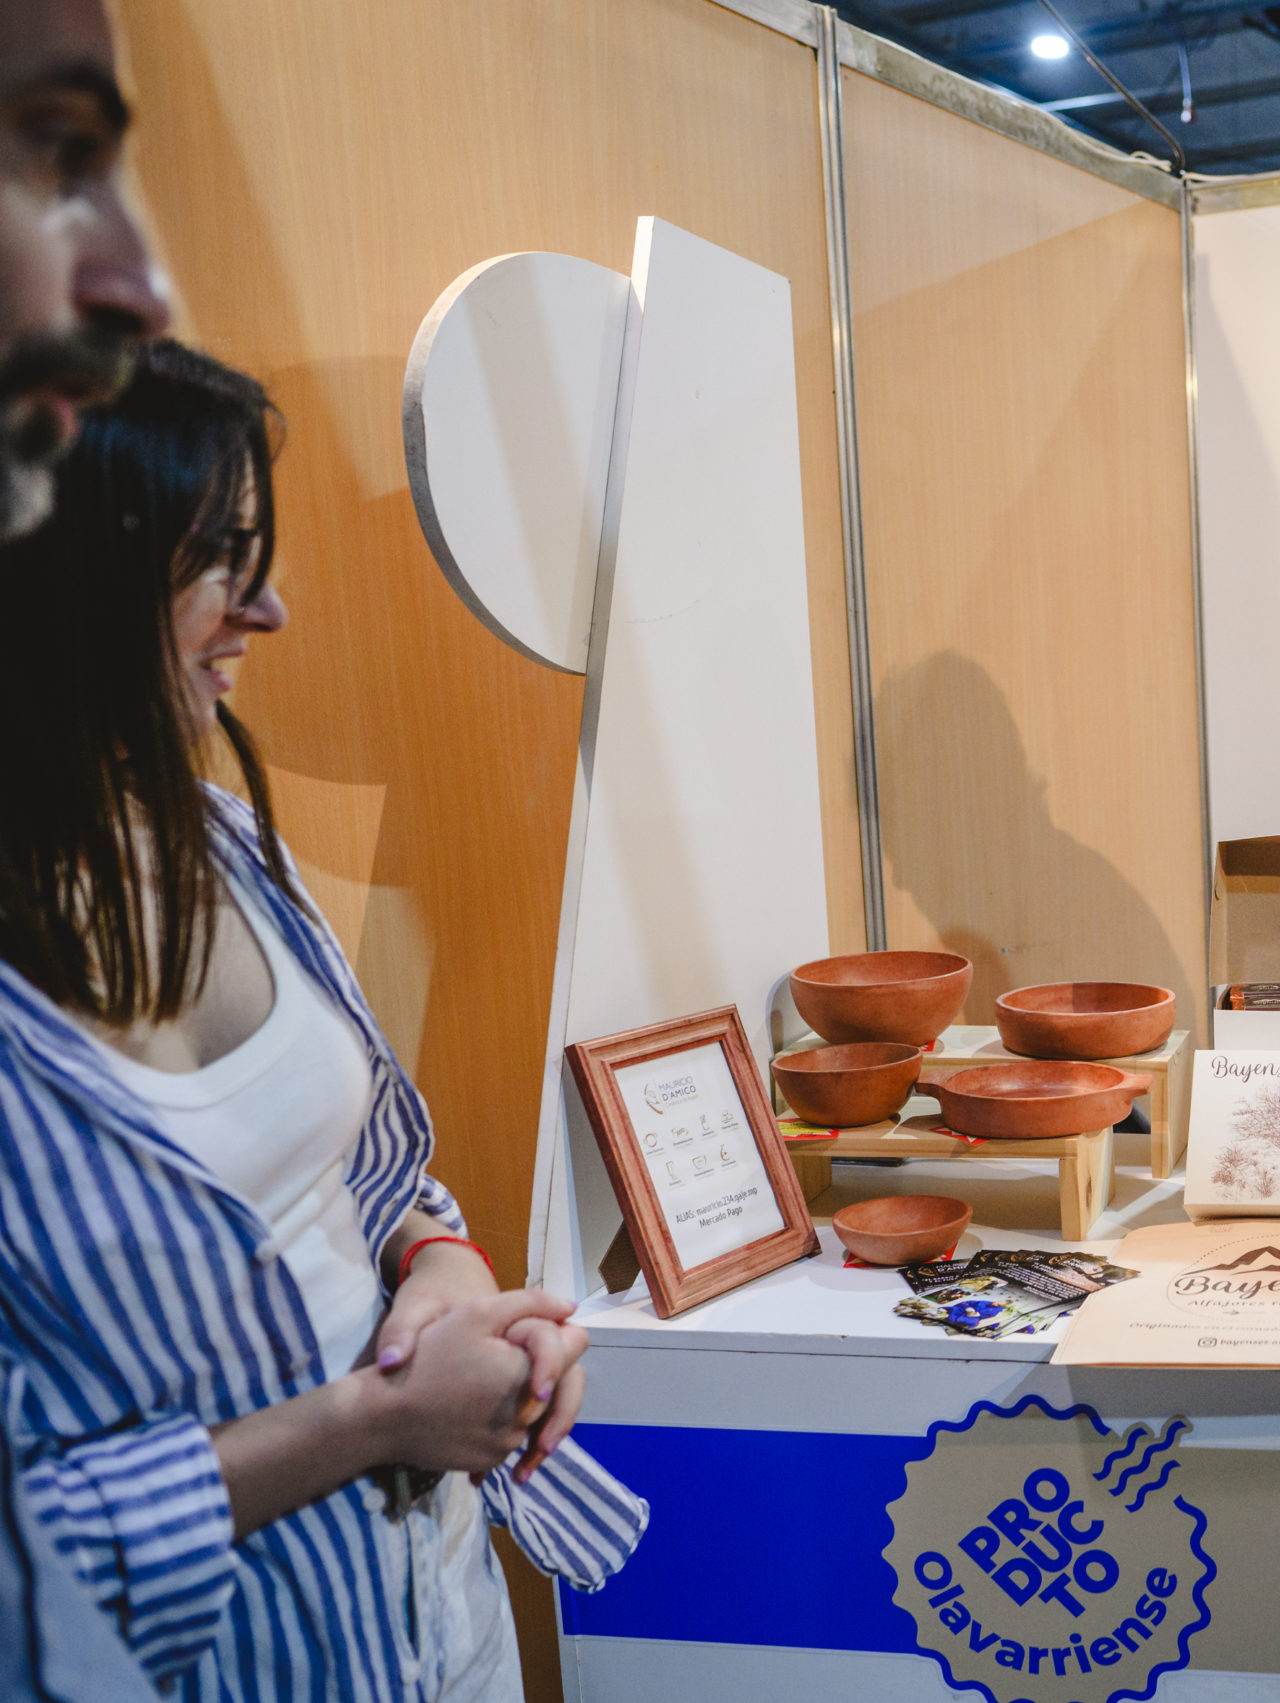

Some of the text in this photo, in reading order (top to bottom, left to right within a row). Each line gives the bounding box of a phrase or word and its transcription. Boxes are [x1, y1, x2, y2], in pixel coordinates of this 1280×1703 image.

[699, 1206, 743, 1228] Mercado Pago
[1187, 1299, 1265, 1308] Alfajores
[957, 1467, 1070, 1575] PRO
[990, 1500, 1104, 1607] DUC
[913, 1551, 1178, 1677] Olavarriense
[1037, 1549, 1120, 1618] TO
